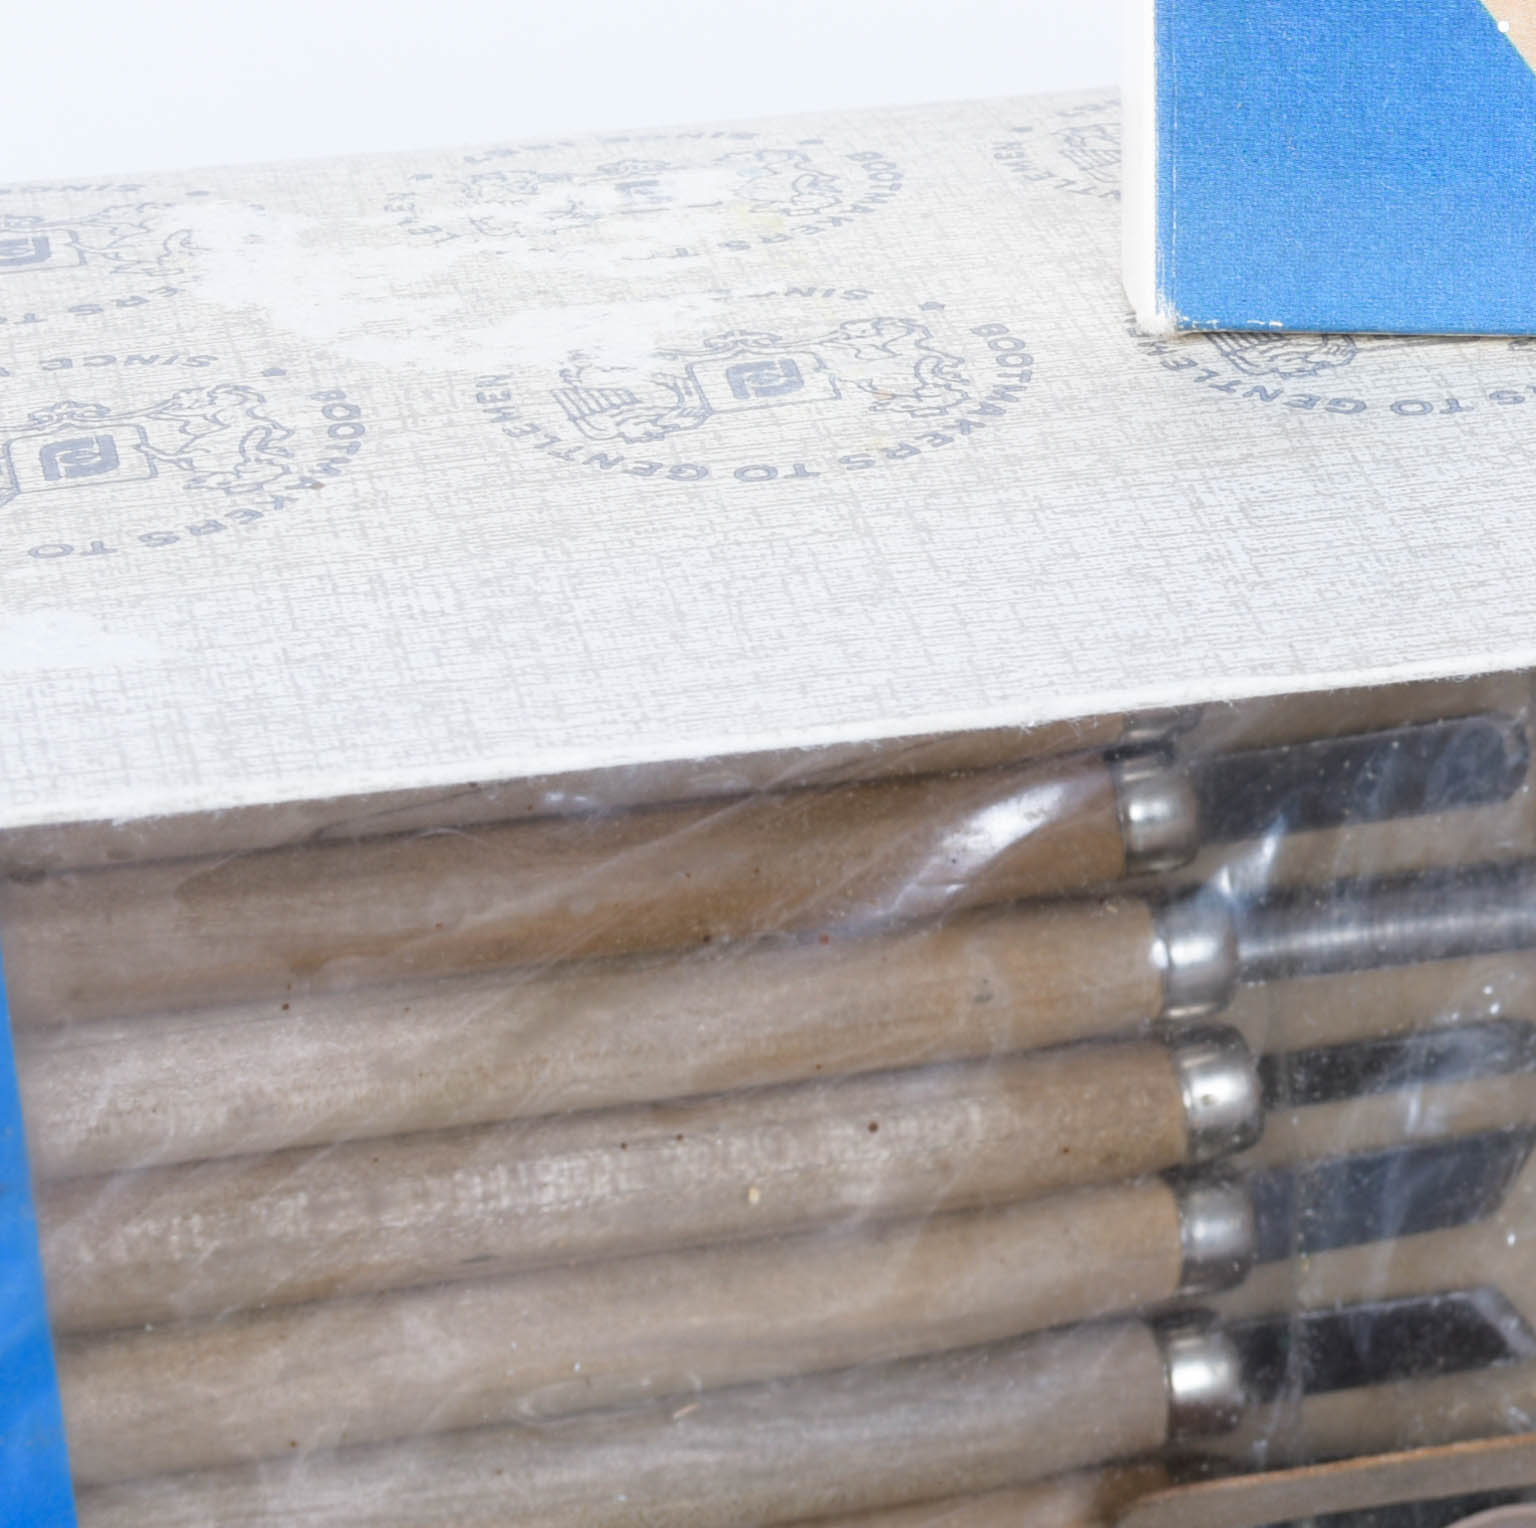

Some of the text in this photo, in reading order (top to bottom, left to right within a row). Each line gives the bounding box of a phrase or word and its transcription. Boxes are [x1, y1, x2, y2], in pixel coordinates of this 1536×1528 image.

[38, 353, 219, 373] SINCE
[470, 322, 1037, 484] BOOTMAKERS TO GENTLEMEN
[1390, 397, 1473, 418] TO
[26, 539, 119, 561] TO
